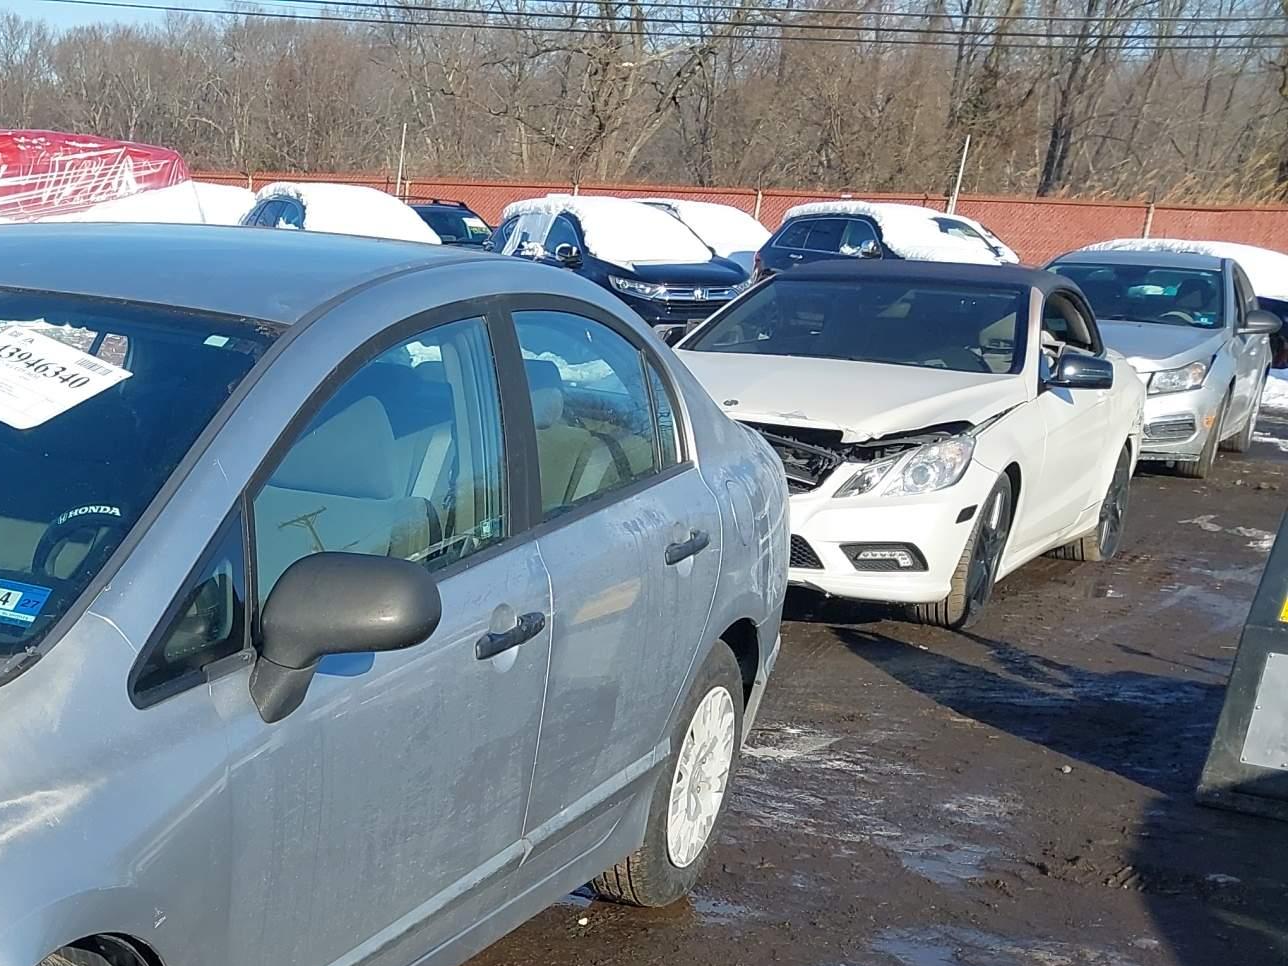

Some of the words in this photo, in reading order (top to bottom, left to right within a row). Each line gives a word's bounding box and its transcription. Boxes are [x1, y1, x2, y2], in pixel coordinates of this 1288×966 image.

[68, 505, 121, 519] HONDA
[0, 592, 12, 605] 4
[21, 599, 41, 609] 27
